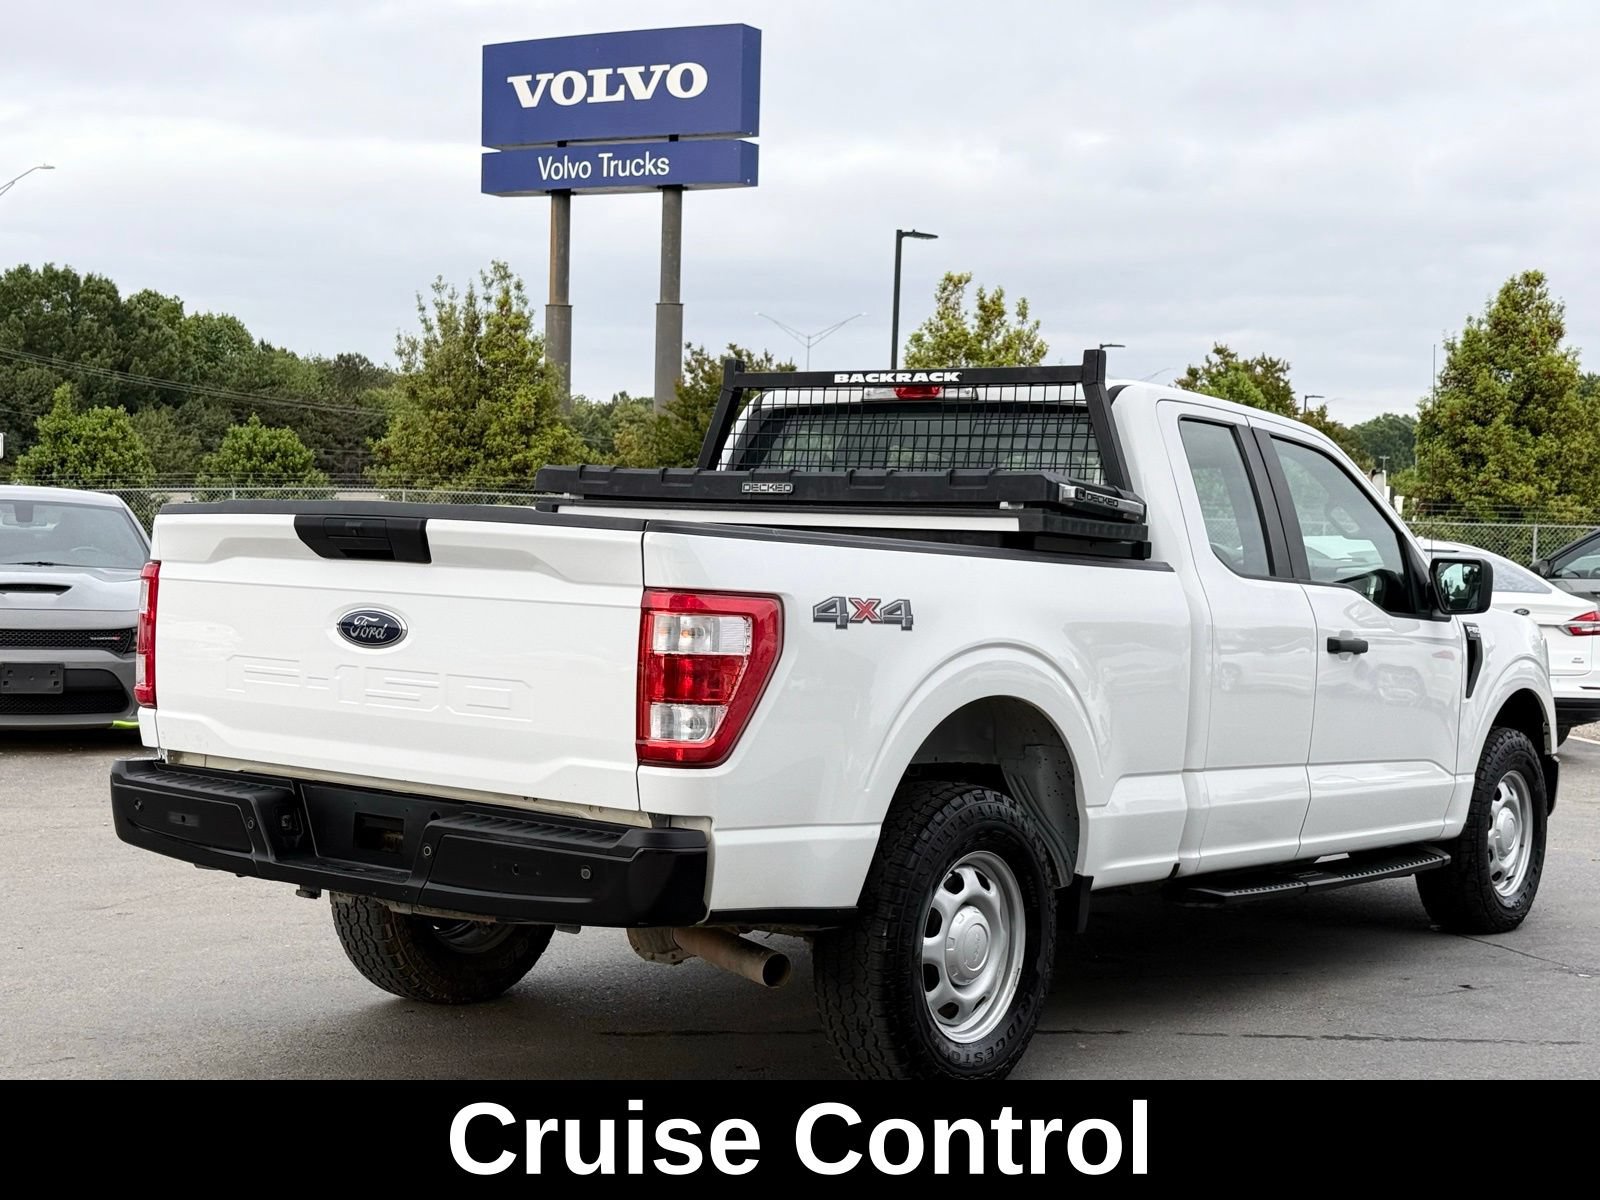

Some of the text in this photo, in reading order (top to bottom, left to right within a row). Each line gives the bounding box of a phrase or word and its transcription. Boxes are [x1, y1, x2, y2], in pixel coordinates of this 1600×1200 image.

[507, 62, 708, 108] VOLVO
[538, 151, 670, 180] Volvo Trucks
[834, 372, 960, 384] BACKRACK
[742, 483, 793, 493] DECKED
[350, 615, 388, 639] Ford
